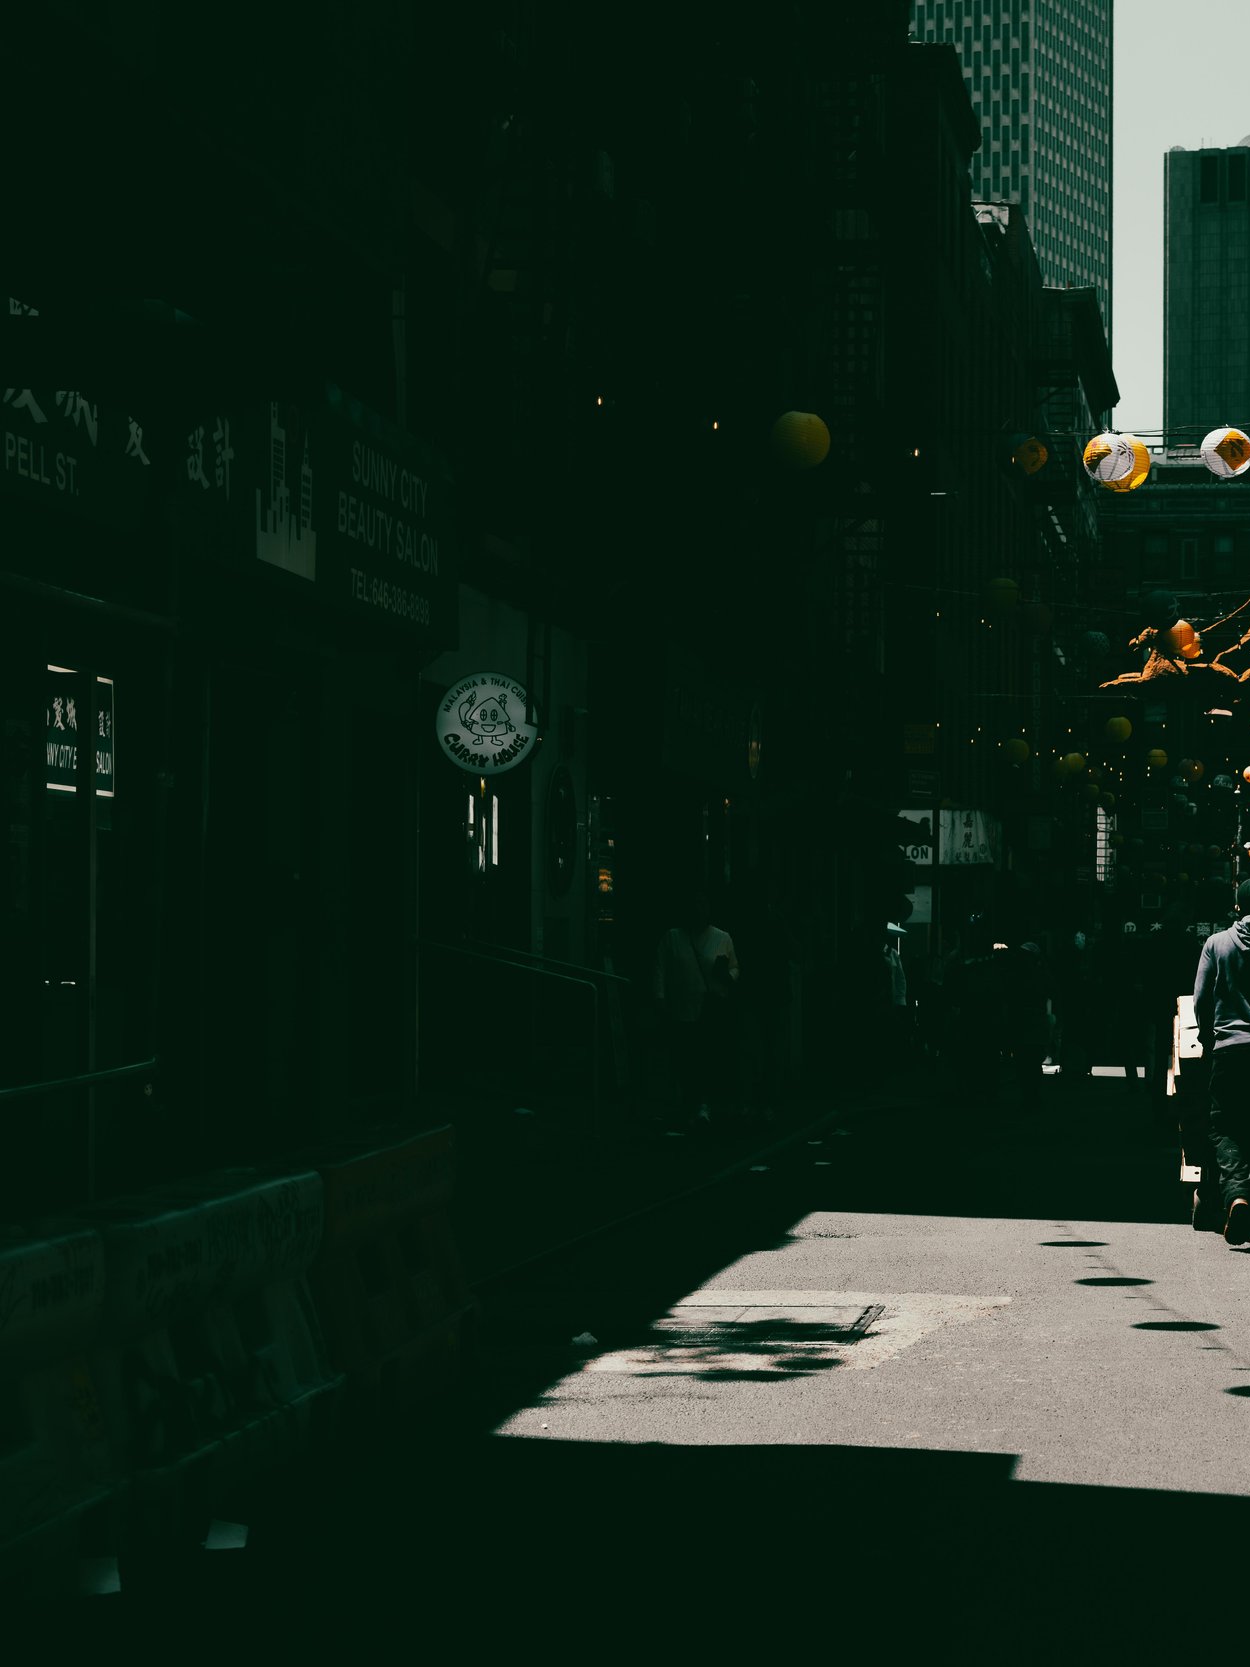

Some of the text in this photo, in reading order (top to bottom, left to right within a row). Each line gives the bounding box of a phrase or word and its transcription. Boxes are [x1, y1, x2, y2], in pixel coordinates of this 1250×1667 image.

[5, 432, 79, 496] PELL ST.
[352, 440, 428, 518] SUNNY CITY
[337, 490, 439, 577] BEAUTY SALON
[443, 677, 528, 713] MALAYSIA & THAI CUIS
[444, 733, 530, 768] CURRY HOUSE
